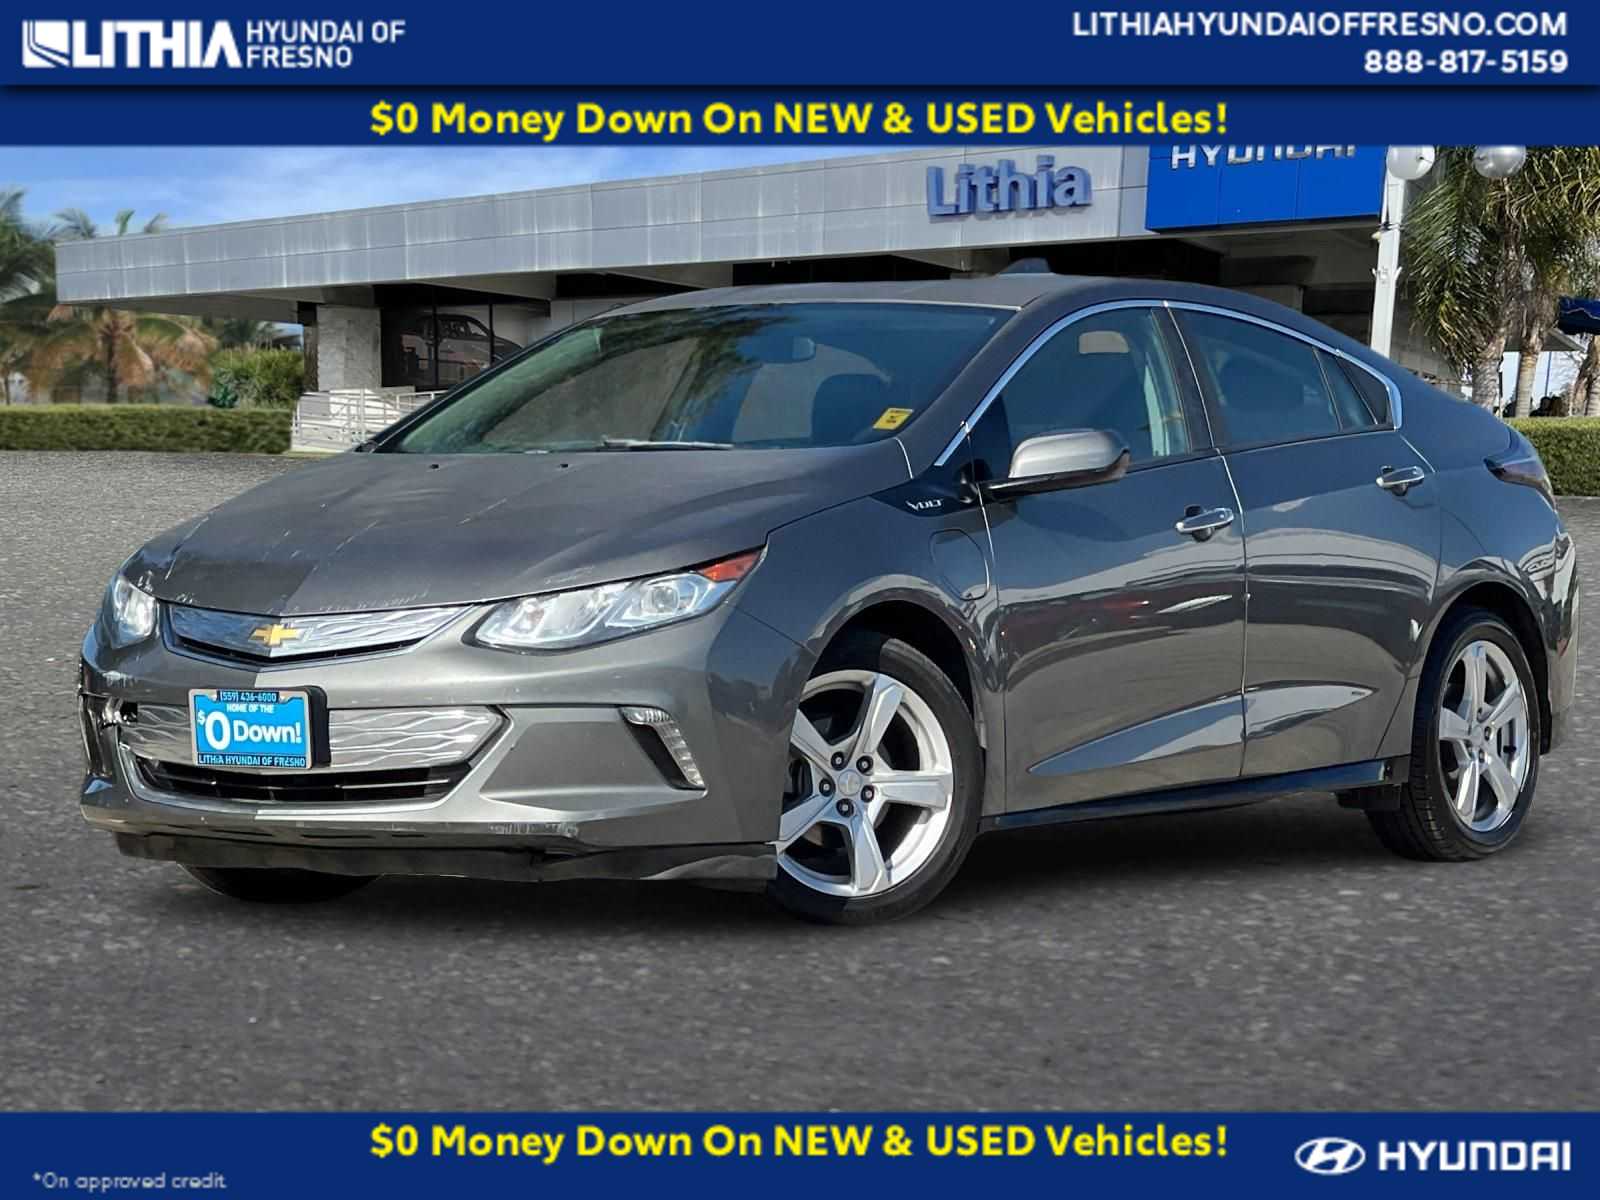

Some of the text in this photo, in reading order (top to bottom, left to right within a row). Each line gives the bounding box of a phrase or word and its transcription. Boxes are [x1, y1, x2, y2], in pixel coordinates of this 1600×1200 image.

[926, 154, 1093, 219] Lithia
[905, 499, 944, 511] VOLT
[220, 691, 277, 702] (559) 436-6000
[226, 703, 275, 713] HOME OF THE
[233, 719, 302, 744] Down!
[199, 754, 225, 764] LITHIA
[225, 755, 261, 765] HYUNDAI
[263, 756, 272, 765] OF
